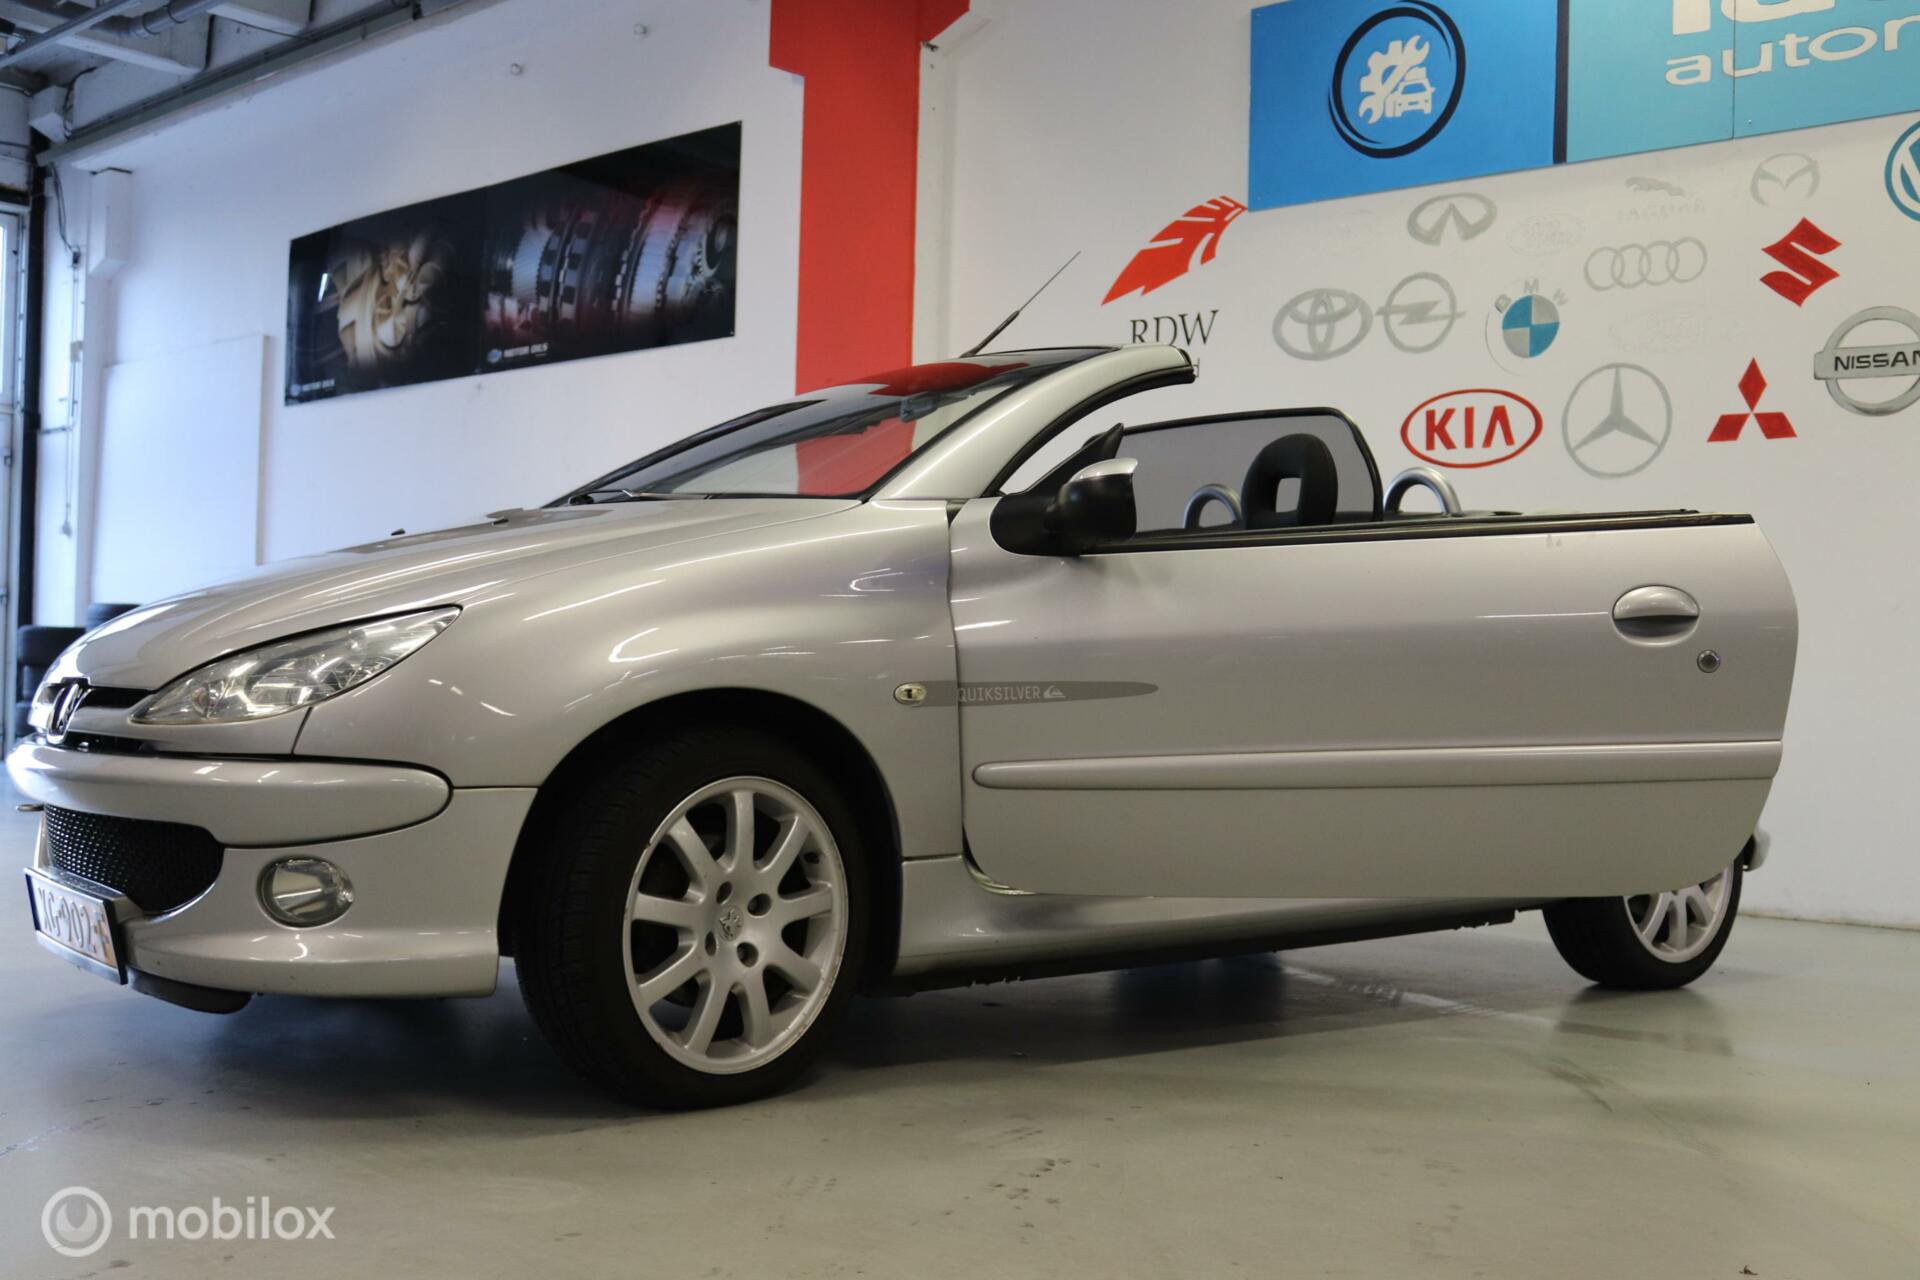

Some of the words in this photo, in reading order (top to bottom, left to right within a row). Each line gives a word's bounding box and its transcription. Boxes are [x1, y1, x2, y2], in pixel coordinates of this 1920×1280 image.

[1130, 309, 1219, 346] RDW
[1425, 405, 1515, 451] KIA
[959, 686, 1041, 702] QUIKSILVER
